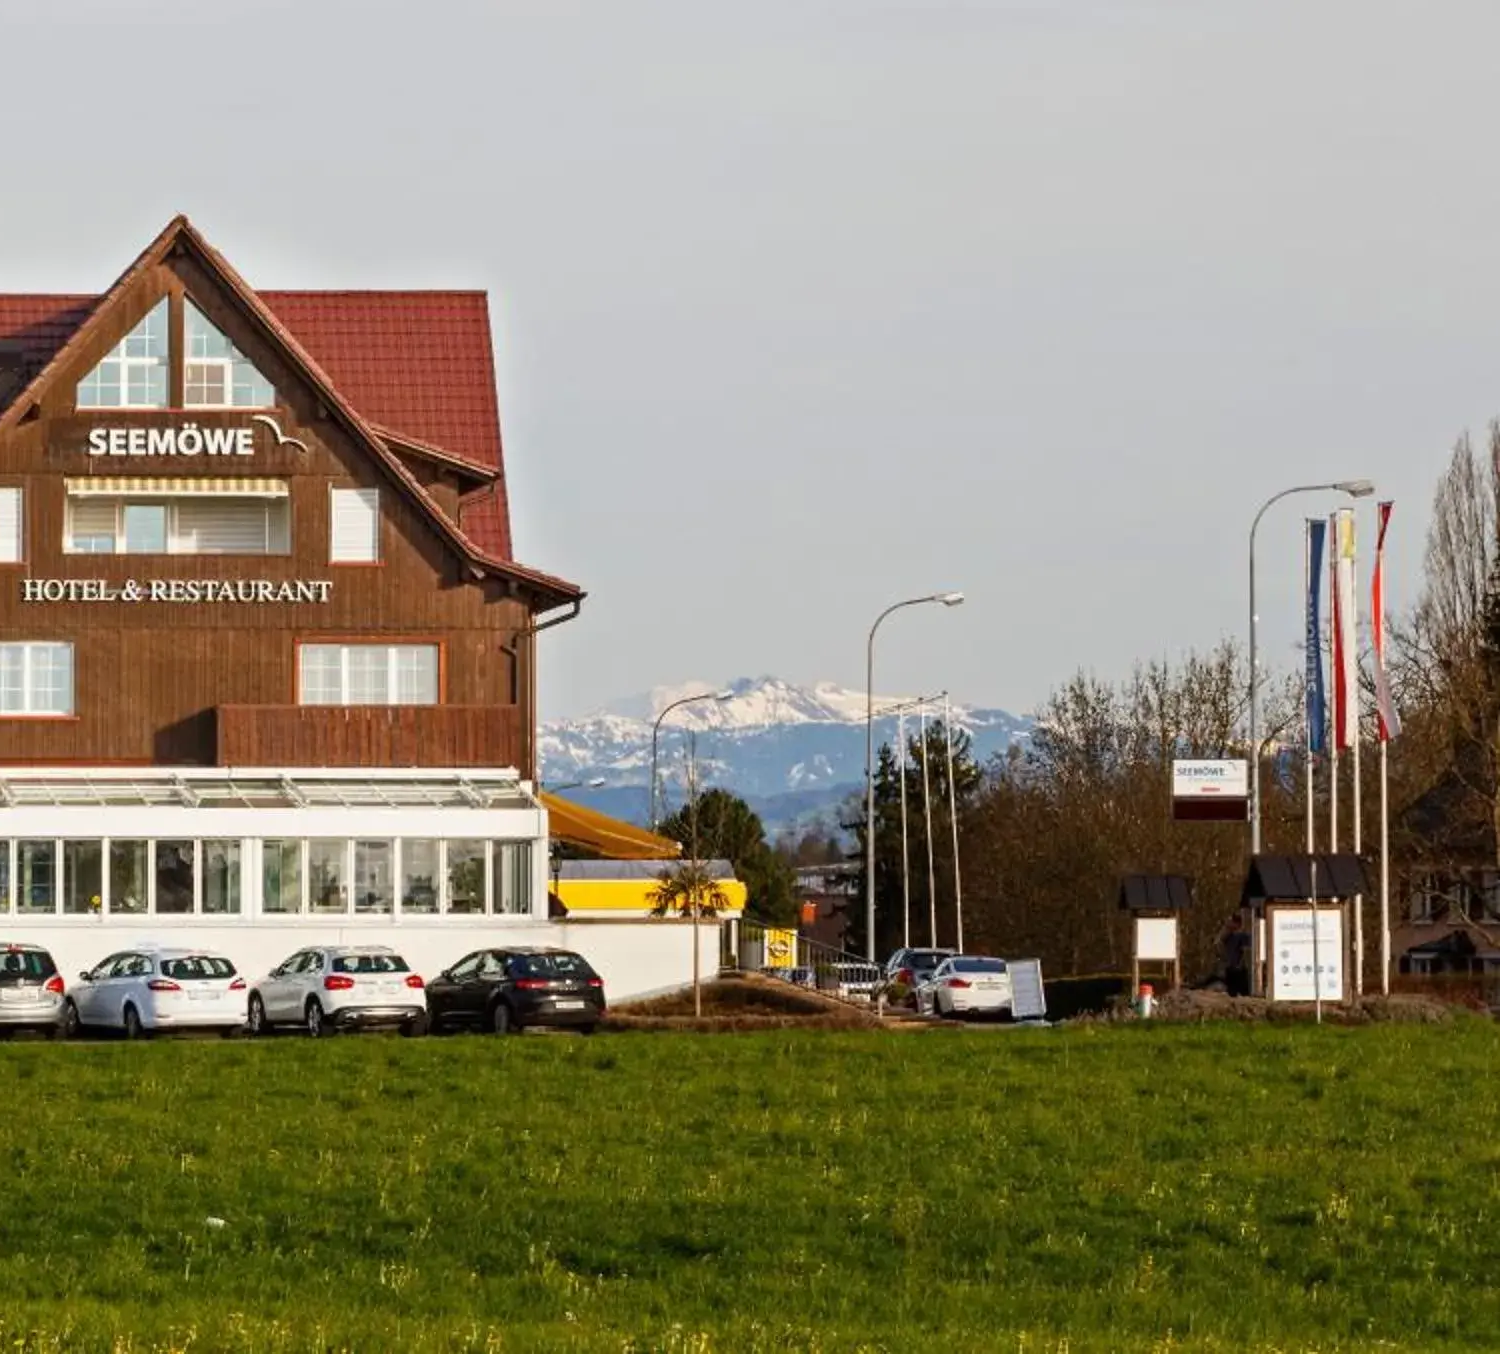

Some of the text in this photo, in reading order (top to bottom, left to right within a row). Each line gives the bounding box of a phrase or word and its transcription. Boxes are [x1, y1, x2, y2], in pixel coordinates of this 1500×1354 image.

[88, 423, 254, 456] SEEMÖWE
[23, 579, 333, 602] HOTEL & RESTAURANT
